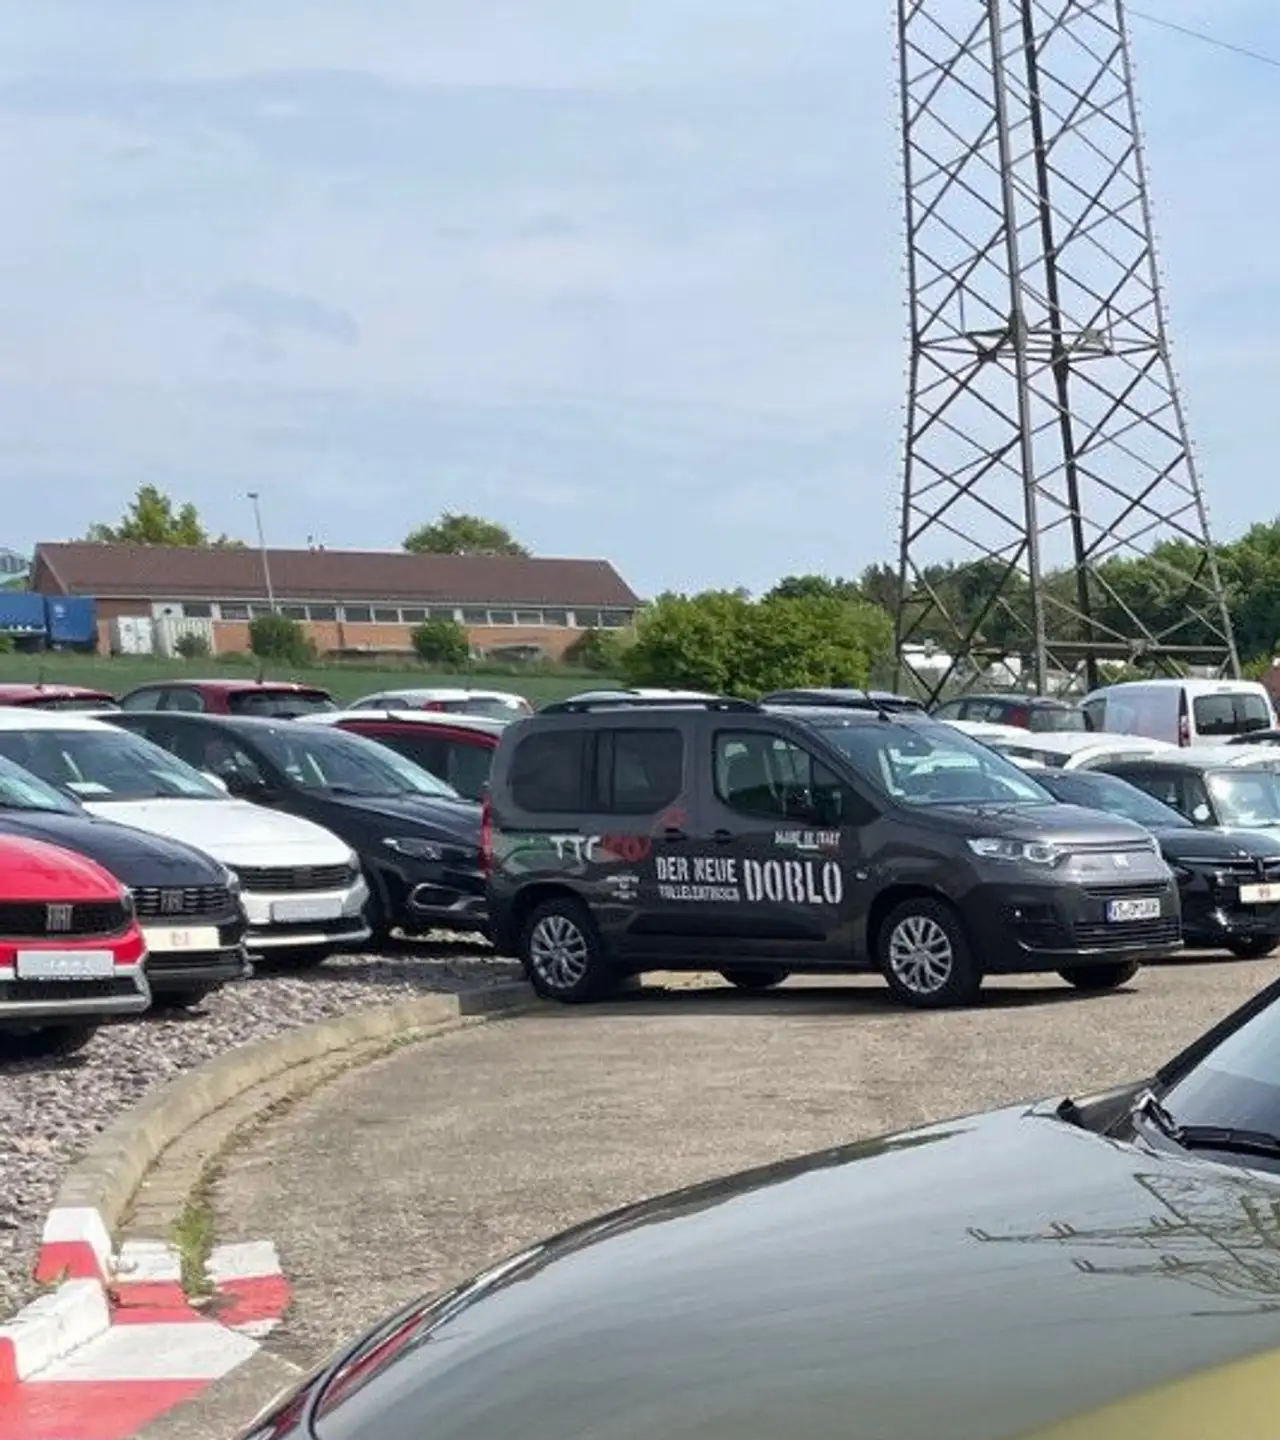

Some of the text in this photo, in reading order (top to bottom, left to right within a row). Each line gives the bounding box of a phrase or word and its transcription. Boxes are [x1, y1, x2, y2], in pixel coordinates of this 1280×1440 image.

[655, 856, 738, 884] DER NEUE
[743, 858, 843, 905] DOBLO
